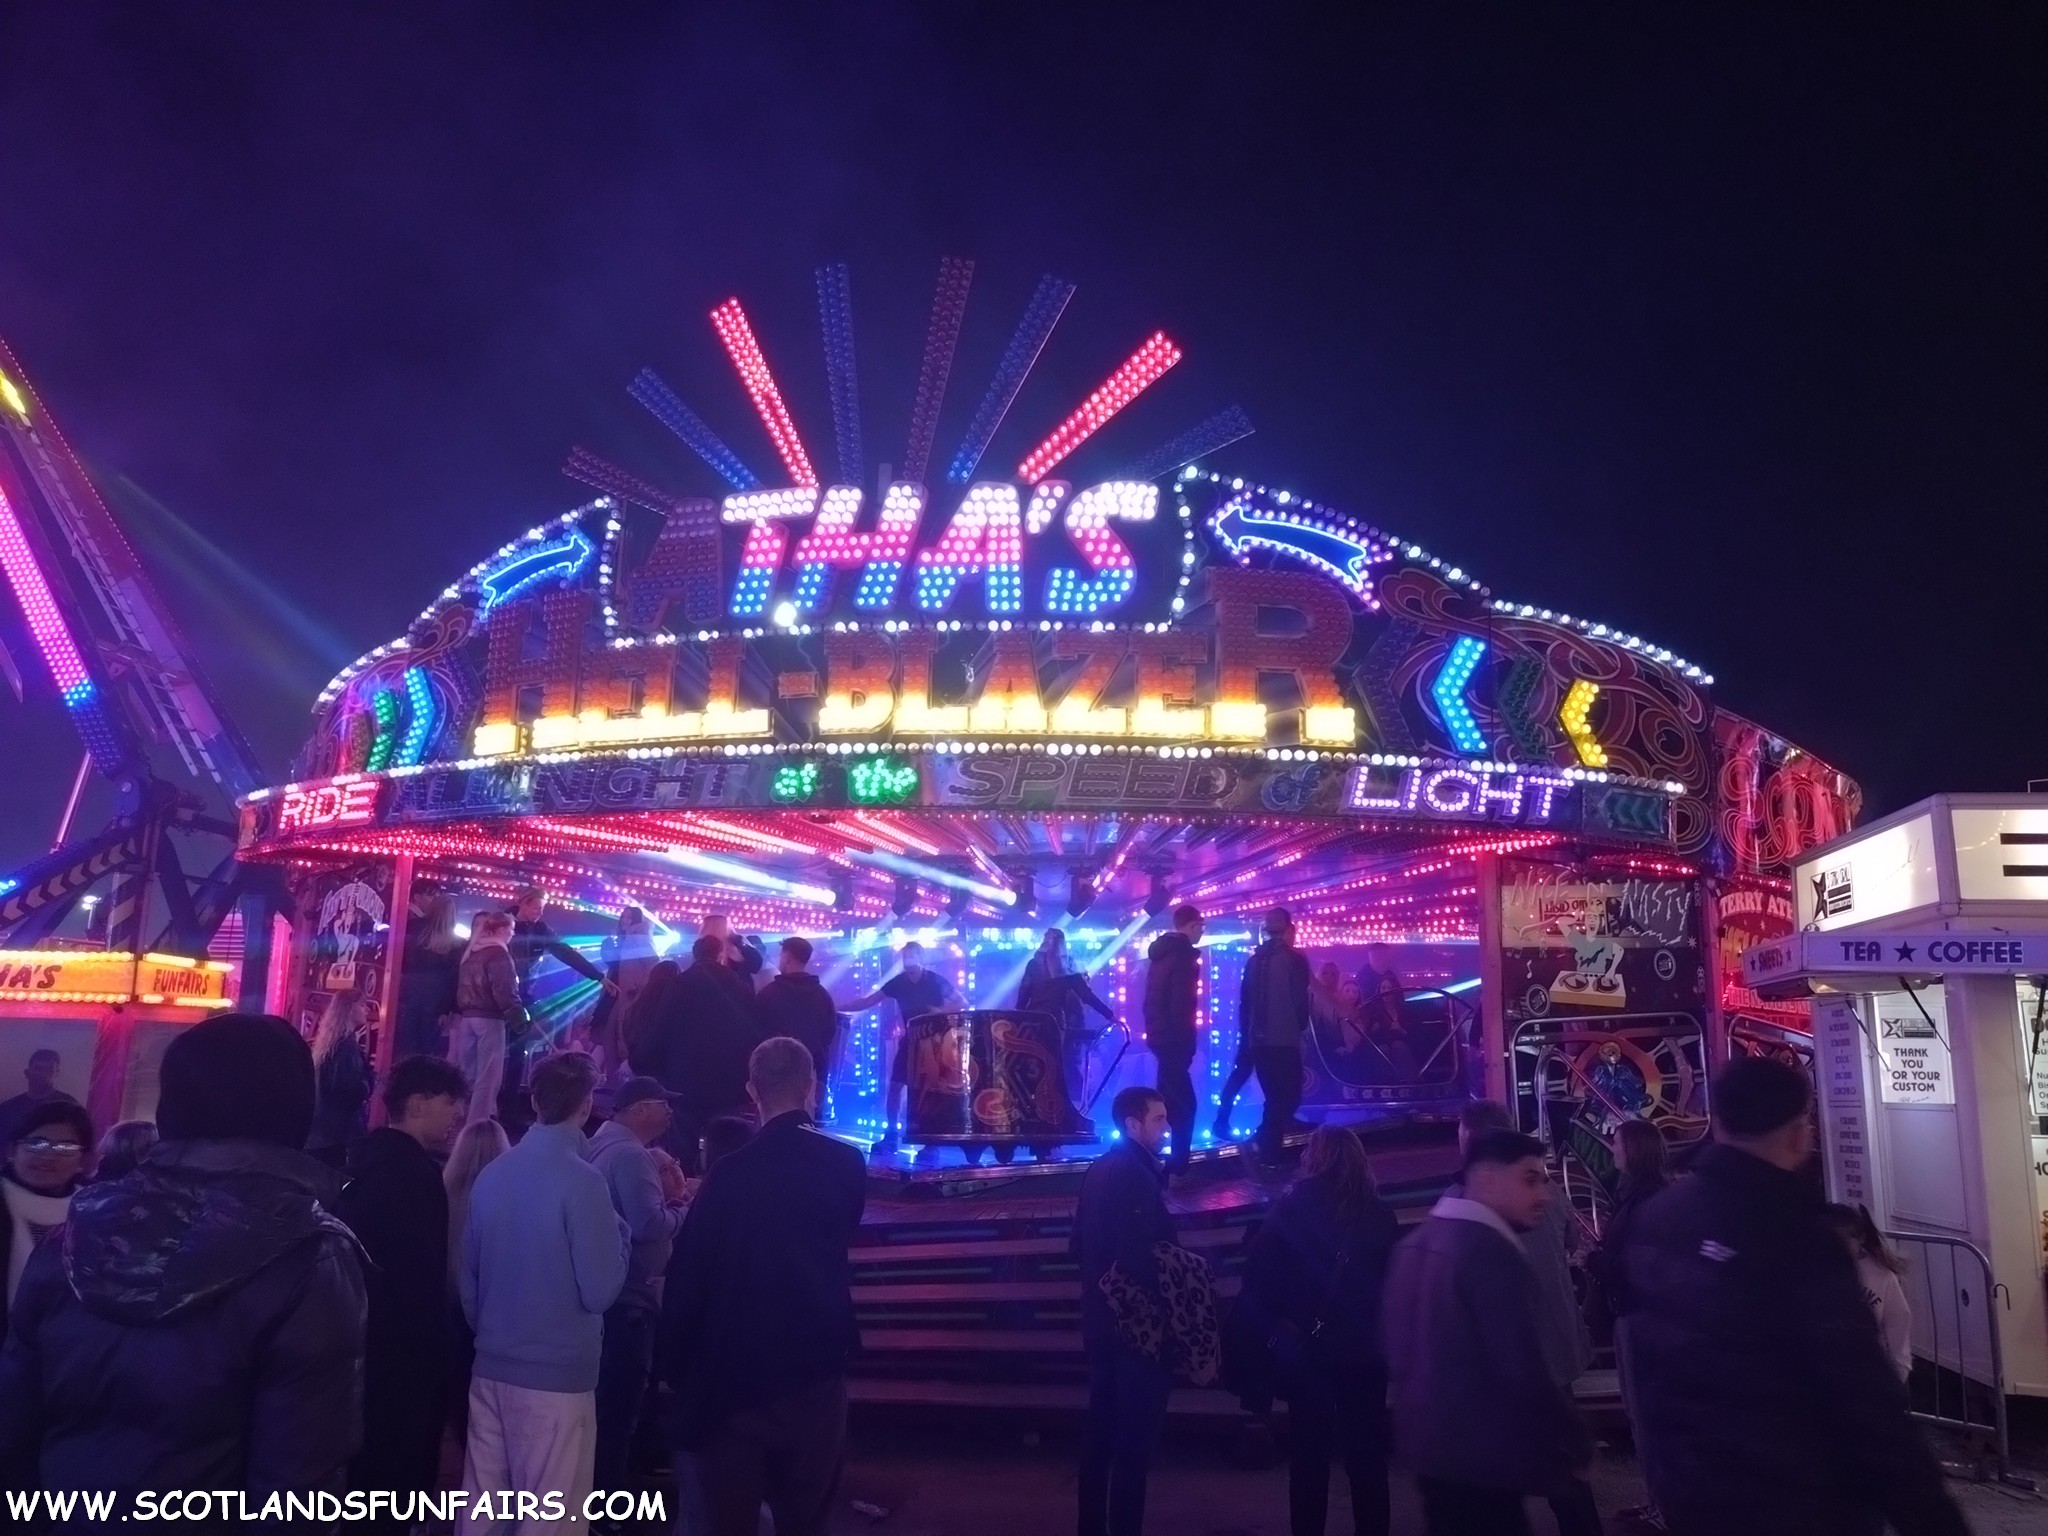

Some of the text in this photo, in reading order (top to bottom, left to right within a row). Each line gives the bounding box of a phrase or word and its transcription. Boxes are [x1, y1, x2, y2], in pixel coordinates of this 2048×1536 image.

[279, 777, 378, 830] RIDE
[532, 758, 750, 811] NIGHT
[773, 762, 818, 801] at
[849, 757, 918, 803] the
[946, 755, 1238, 809] SPEED
[1261, 762, 1321, 811] of
[1347, 766, 1575, 821] LIGHT
[1620, 878, 1692, 932] NASTY
[1720, 891, 1763, 918] TERRY
[1758, 947, 1783, 972] SWEETS
[1840, 940, 2023, 964] TEA COFFEE
[153, 968, 209, 997] FUNFAIRS
[1893, 1047, 1928, 1057] THANK
[1901, 1059, 1924, 1069] YOU
[1892, 1082, 1936, 1092] CUSTOM
[1912, 1071, 1941, 1081] YOUR
